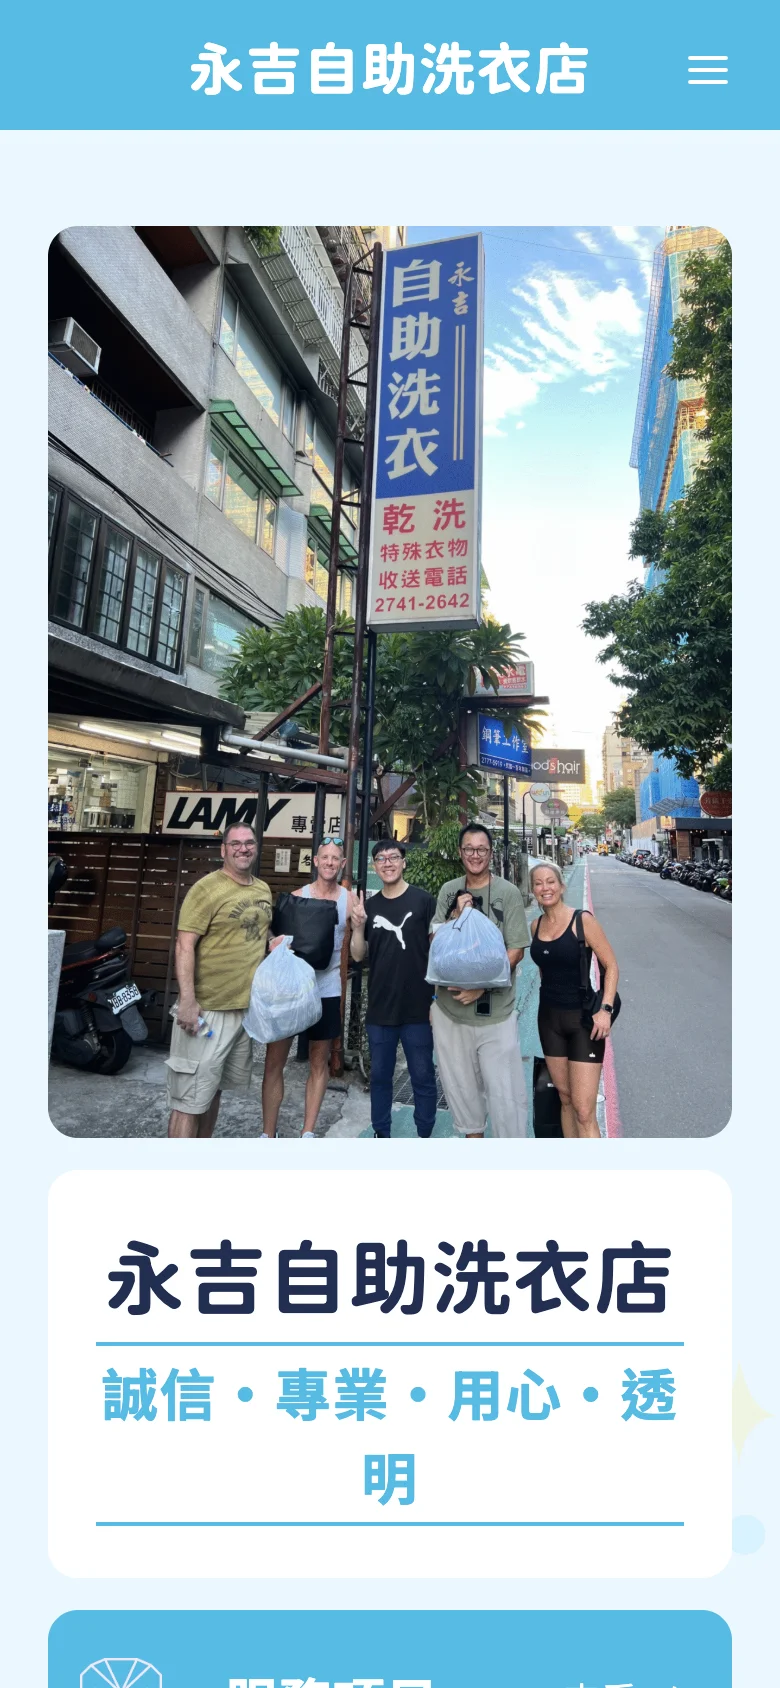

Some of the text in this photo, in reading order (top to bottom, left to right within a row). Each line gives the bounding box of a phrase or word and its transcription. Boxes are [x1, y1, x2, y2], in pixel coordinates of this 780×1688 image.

[190, 41, 589, 96] 永吉自助洗衣店
[447, 260, 475, 316] 永吉
[384, 258, 443, 480] 自助洗衣
[379, 538, 469, 563] 特殊衣物
[374, 593, 470, 613] 2741-2642
[378, 565, 468, 591] 收送電話
[166, 796, 292, 832] LAMY
[107, 1238, 672, 1316] 永吉自助洗衣店
[364, 1453, 415, 1506] 明
